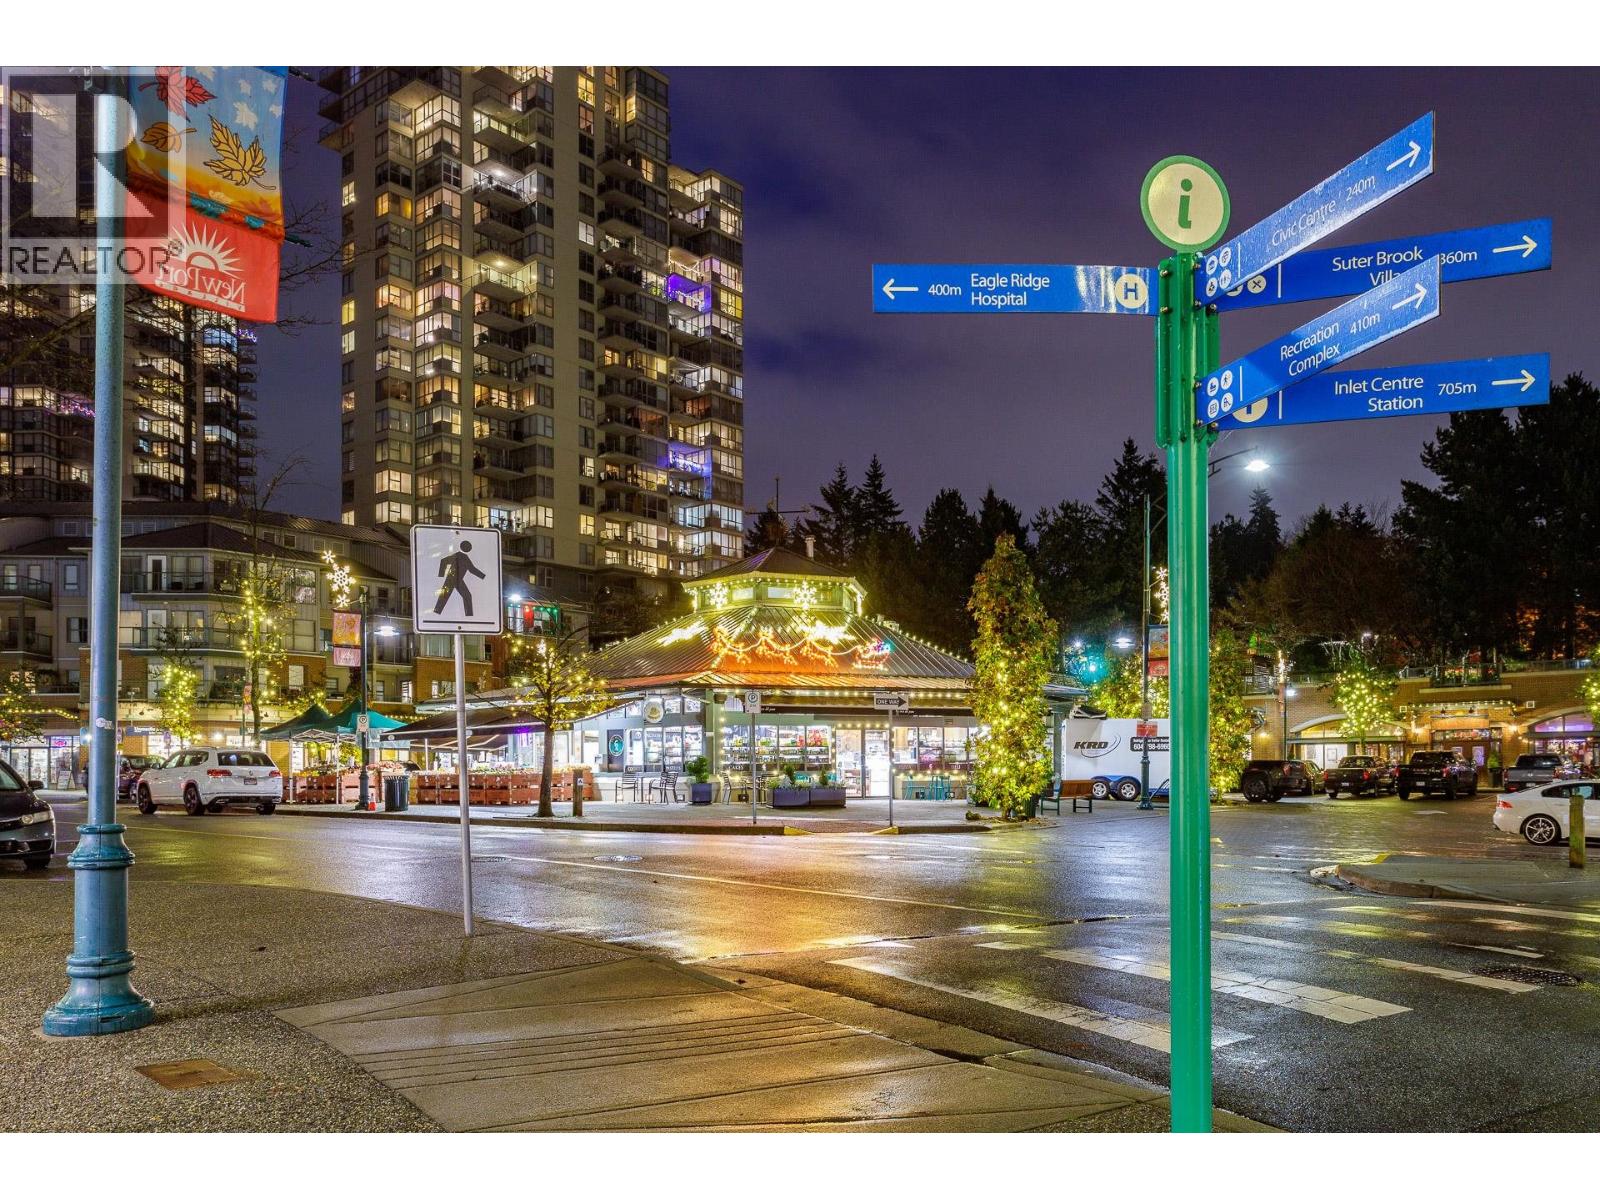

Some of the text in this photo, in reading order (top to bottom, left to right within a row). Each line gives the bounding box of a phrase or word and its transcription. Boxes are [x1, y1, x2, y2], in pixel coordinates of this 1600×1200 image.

[1346, 176, 1376, 201] 240m
[1271, 200, 1336, 247] Civic Centre
[1332, 246, 1423, 272] Suter Brook
[928, 284, 962, 295] 400m
[971, 273, 1050, 291] Eagle Ridge
[971, 291, 1027, 309] Hospital
[1350, 313, 1380, 334] 410m
[1280, 322, 1339, 361] Recreation
[1288, 343, 1340, 376] Complex
[1335, 377, 1424, 395] Inlet Centre
[1438, 382, 1477, 396] 705m
[1368, 396, 1423, 412] Station
[1073, 742, 1109, 750] KRD
